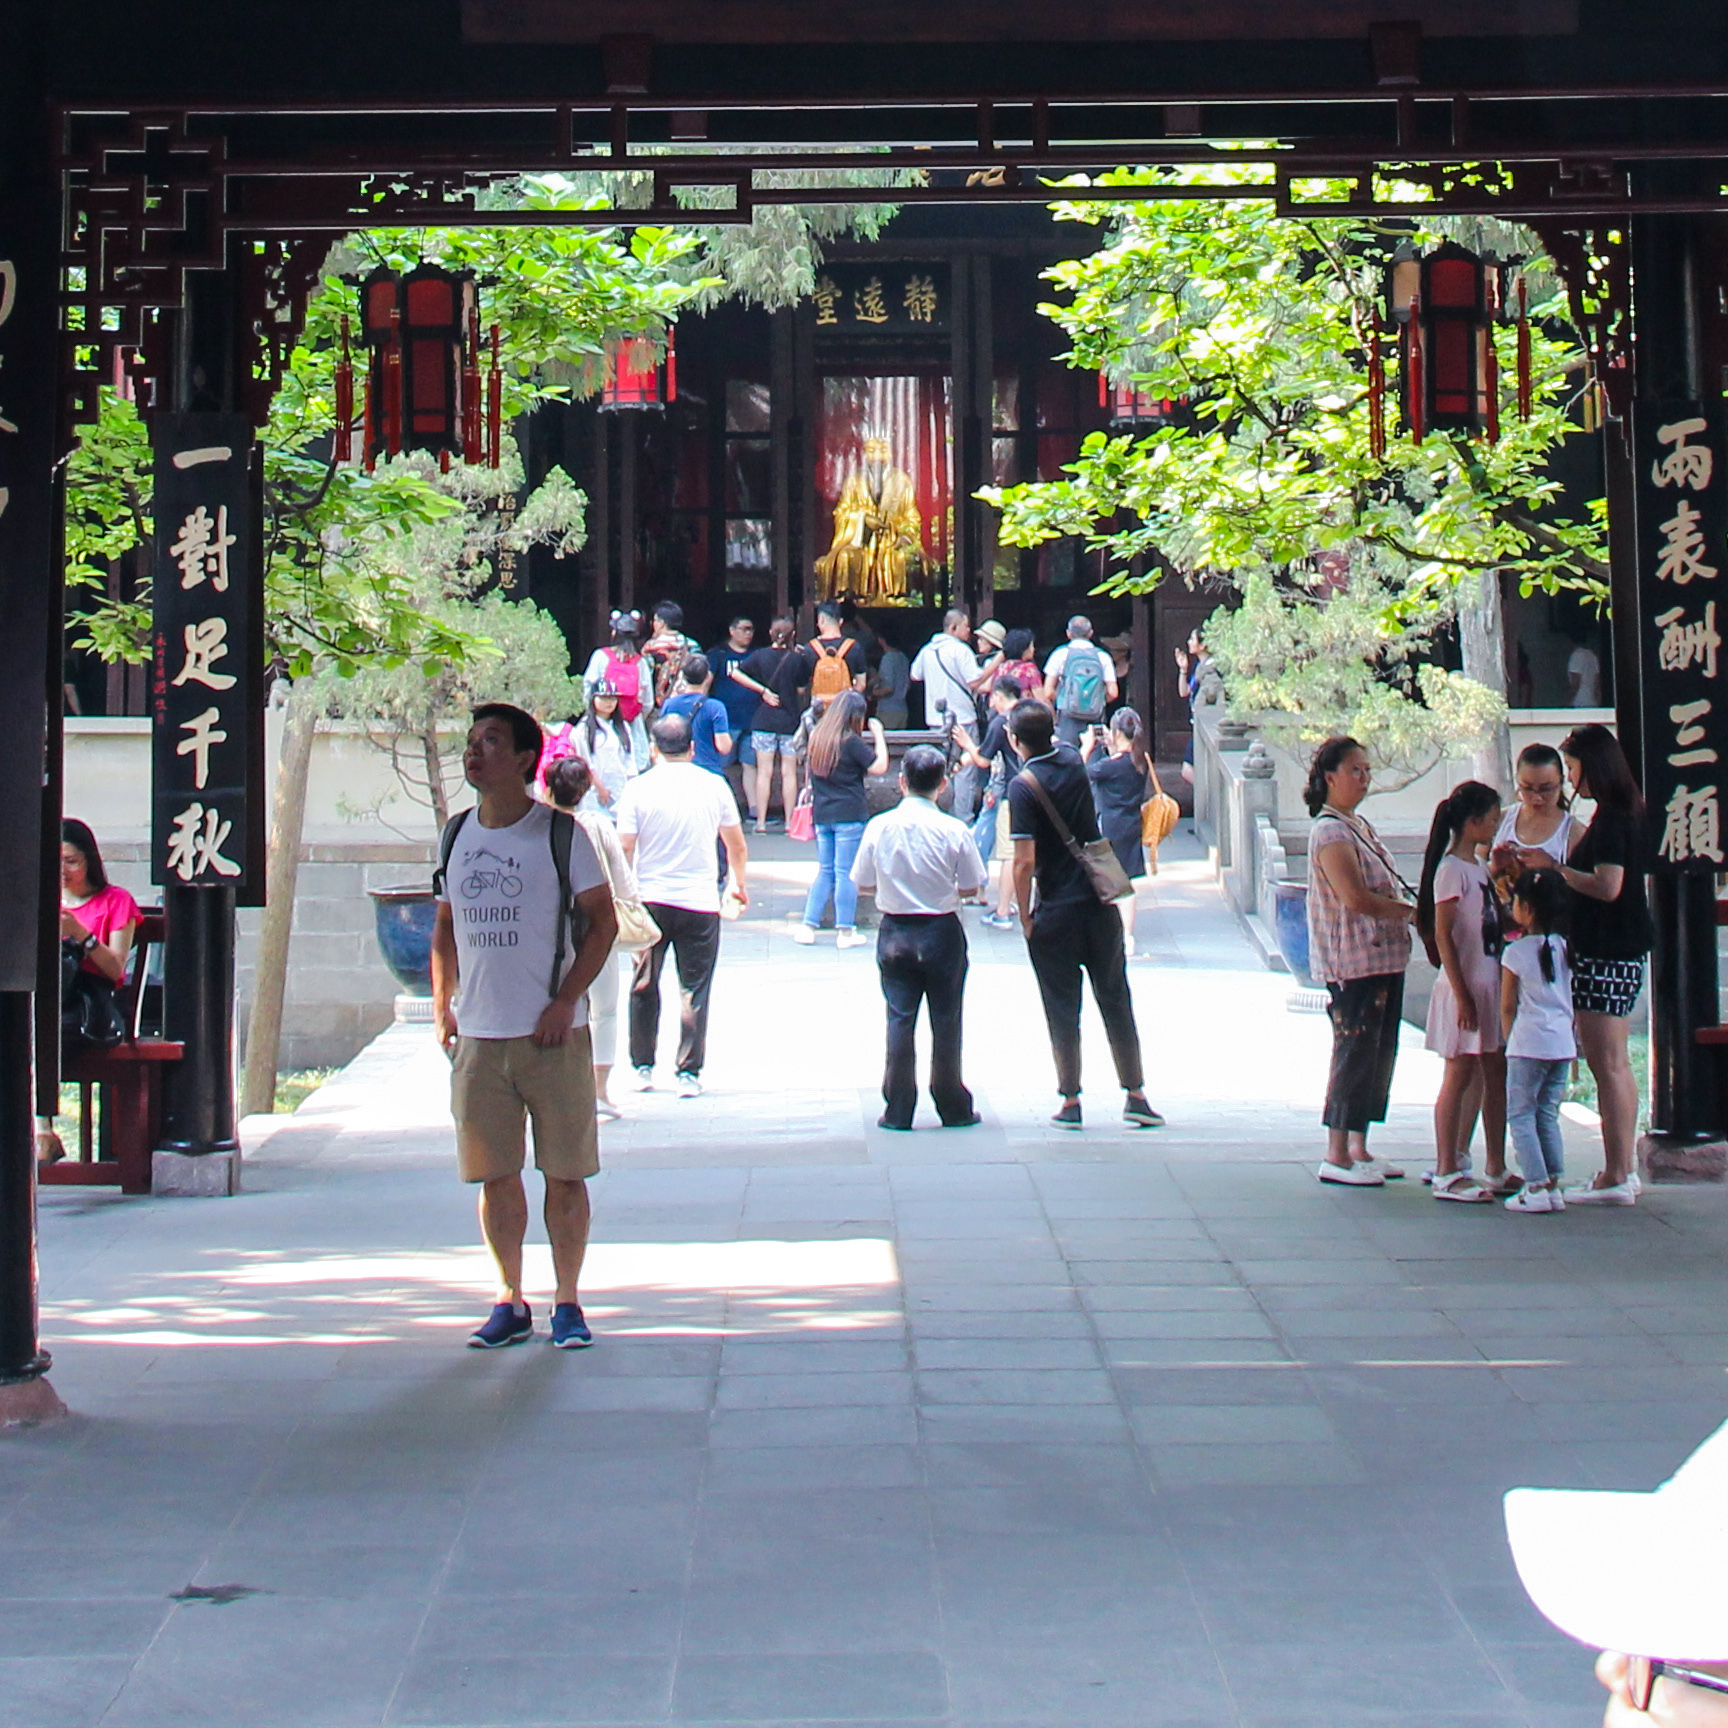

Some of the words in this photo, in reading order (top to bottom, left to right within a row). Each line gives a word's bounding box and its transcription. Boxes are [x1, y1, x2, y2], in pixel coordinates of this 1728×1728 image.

[167, 446, 242, 881] 一對足千秋
[467, 930, 518, 947] WORLD
